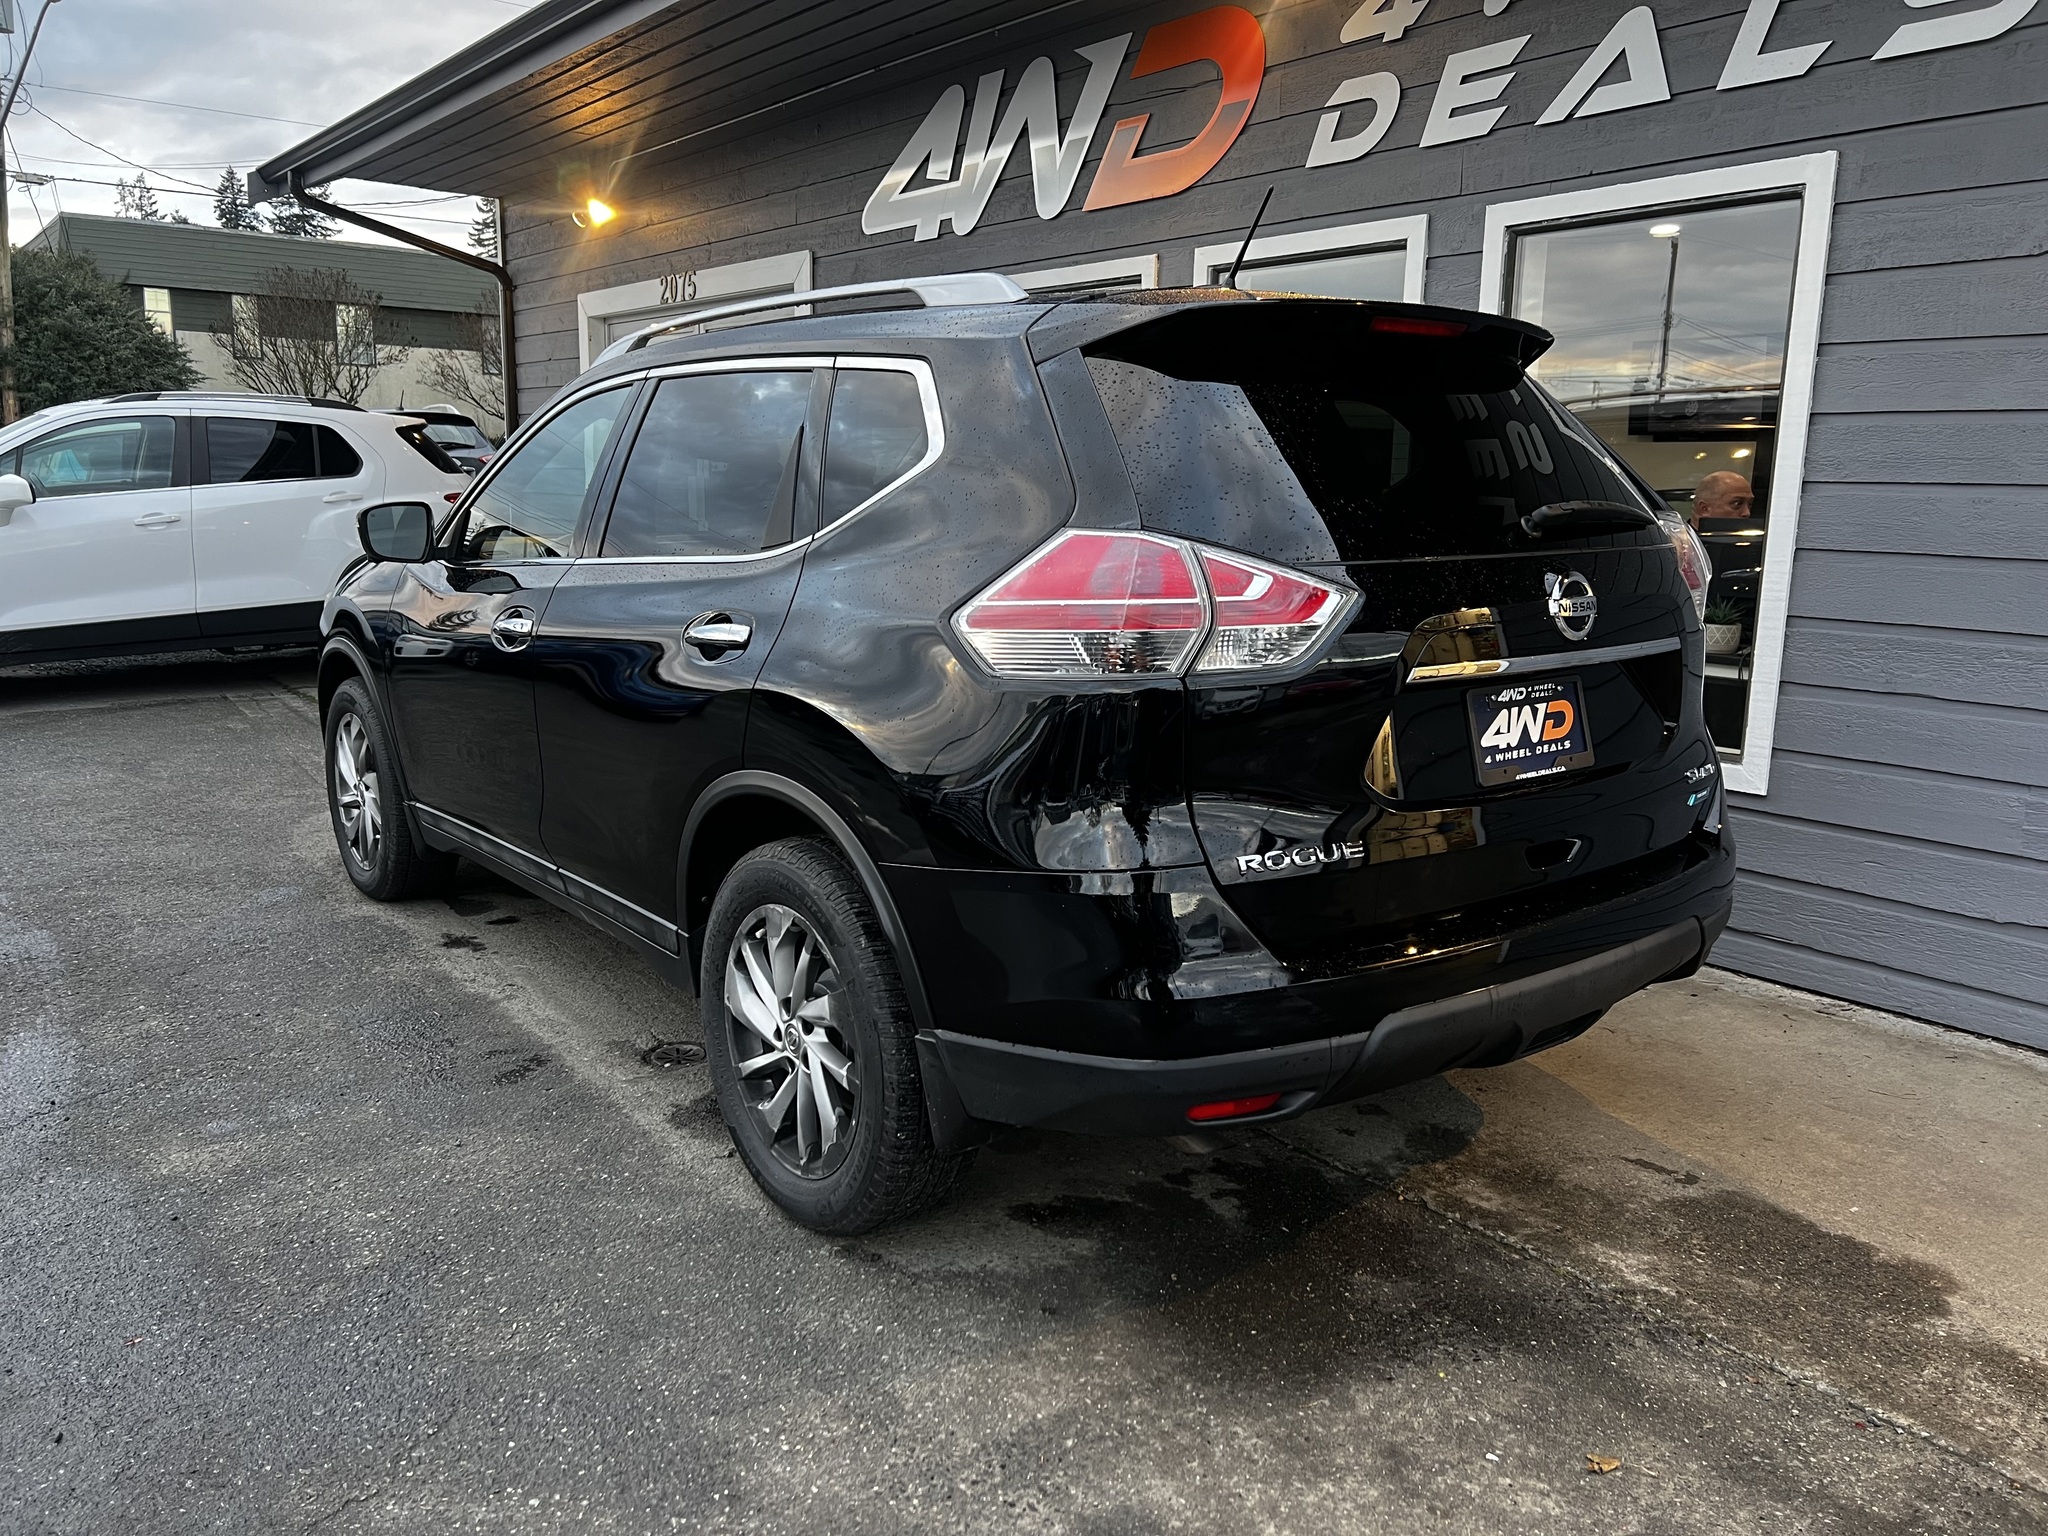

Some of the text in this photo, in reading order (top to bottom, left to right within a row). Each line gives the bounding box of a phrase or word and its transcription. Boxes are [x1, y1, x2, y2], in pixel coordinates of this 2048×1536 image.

[862, 4, 1265, 242] 4WD
[660, 270, 696, 305] 2075
[1559, 601, 1596, 613] NISSAN
[1497, 687, 1526, 701] 4WD
[1531, 690, 1553, 698] DEALS
[1534, 683, 1556, 691] WHEEL
[1480, 699, 1574, 749] 4WD
[1484, 740, 1571, 764] 4 WHEEL DEALS
[1235, 840, 1365, 875] ROGUE
